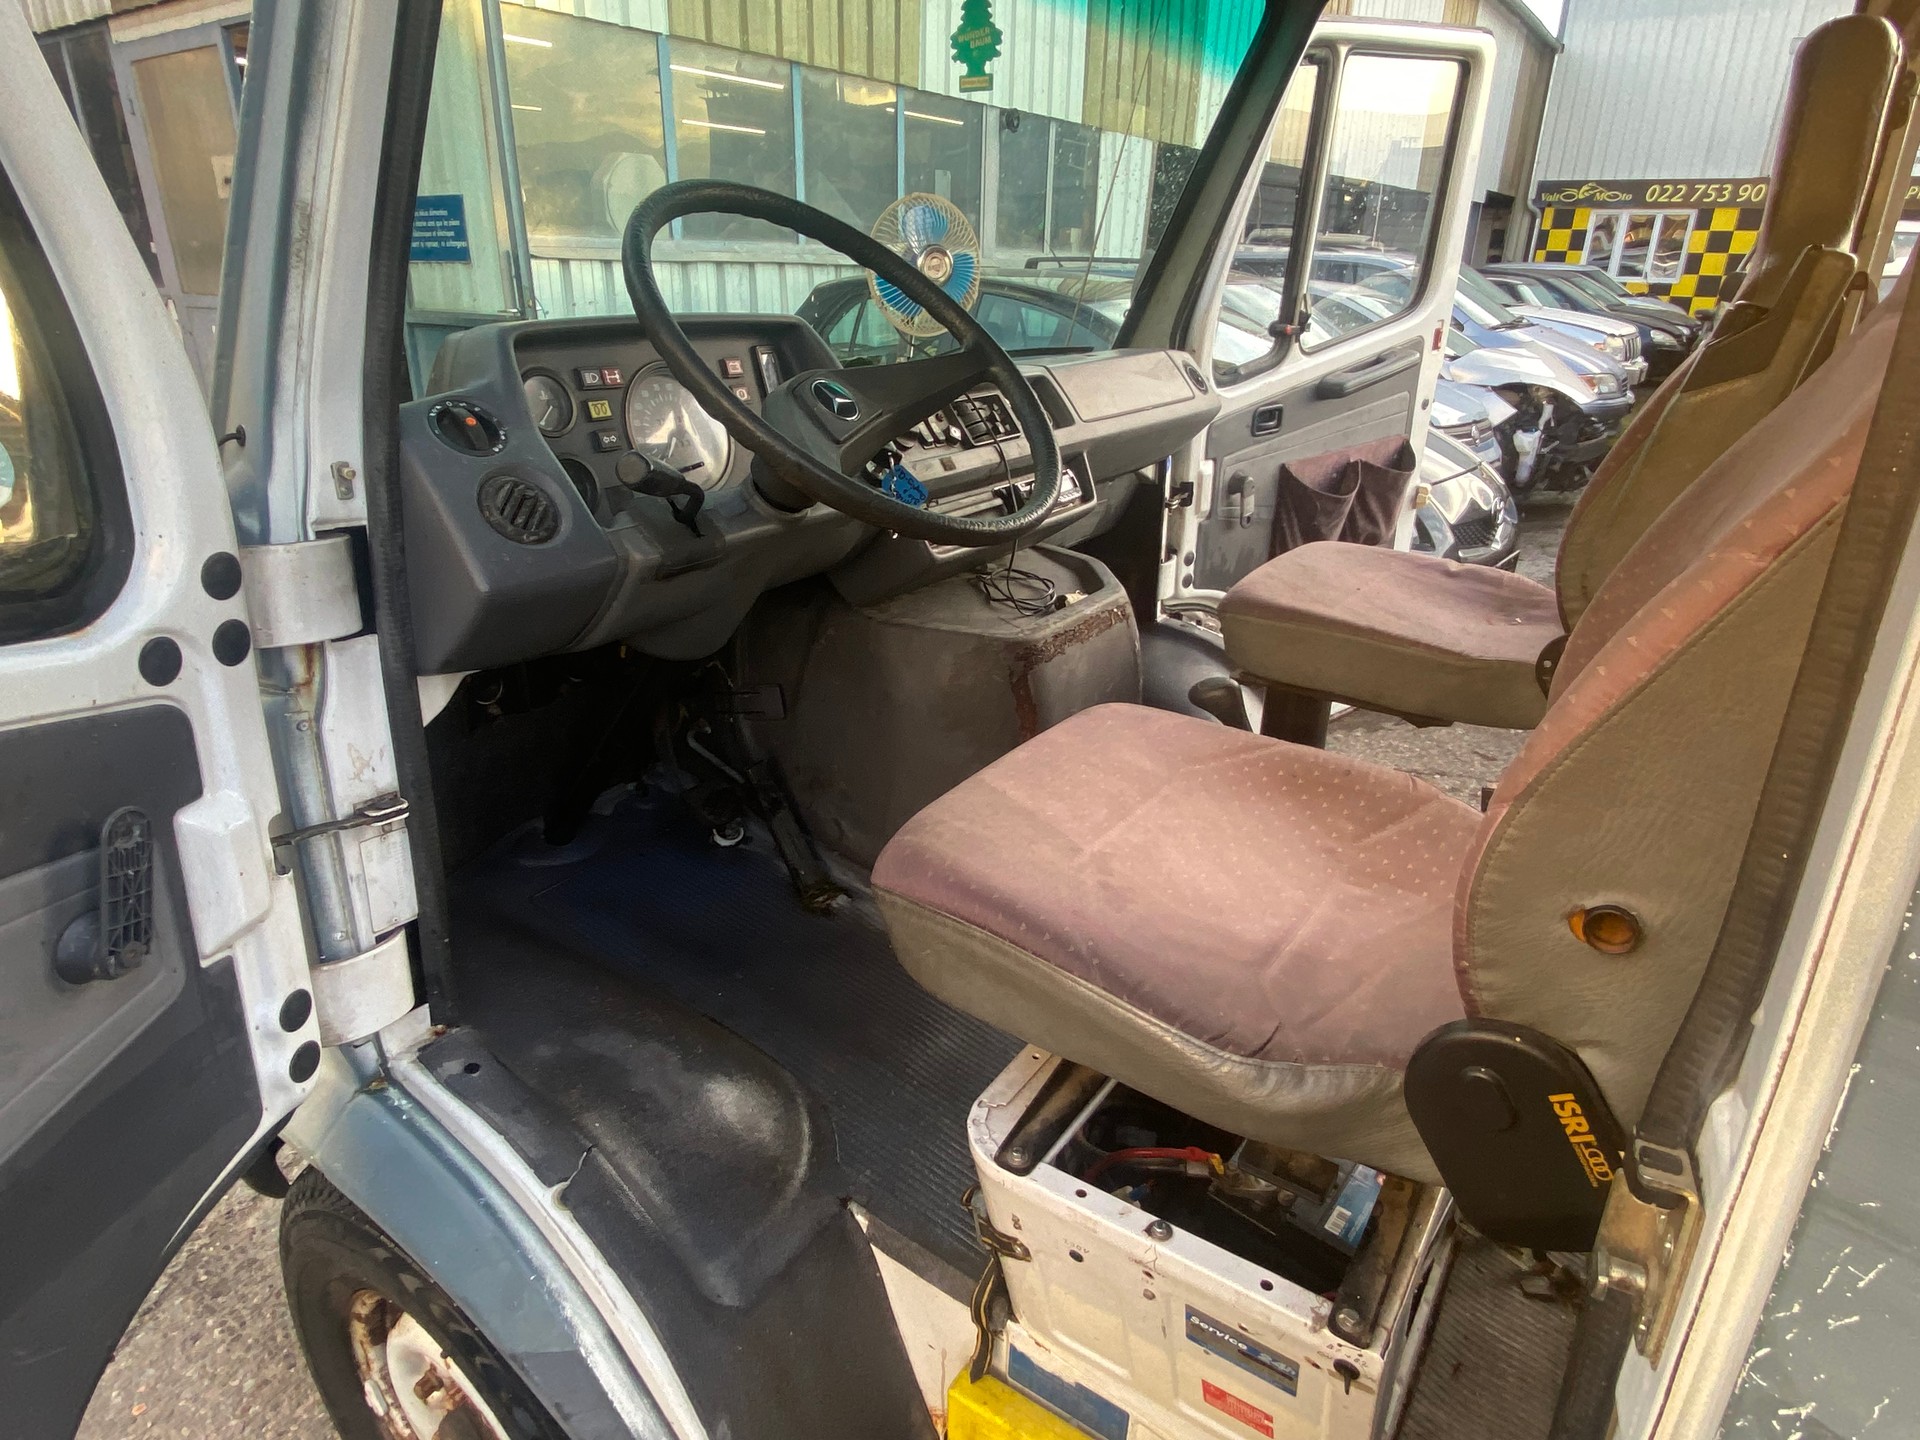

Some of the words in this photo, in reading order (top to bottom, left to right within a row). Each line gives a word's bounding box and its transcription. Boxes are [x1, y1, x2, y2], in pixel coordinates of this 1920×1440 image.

[1645, 184, 1687, 202] 022
[1689, 184, 1733, 202] 753
[1736, 184, 1766, 202] 90
[1548, 1093, 1597, 1143] ISRI
[1190, 1315, 1248, 1350] Service
[1258, 1352, 1297, 1376] 24h
